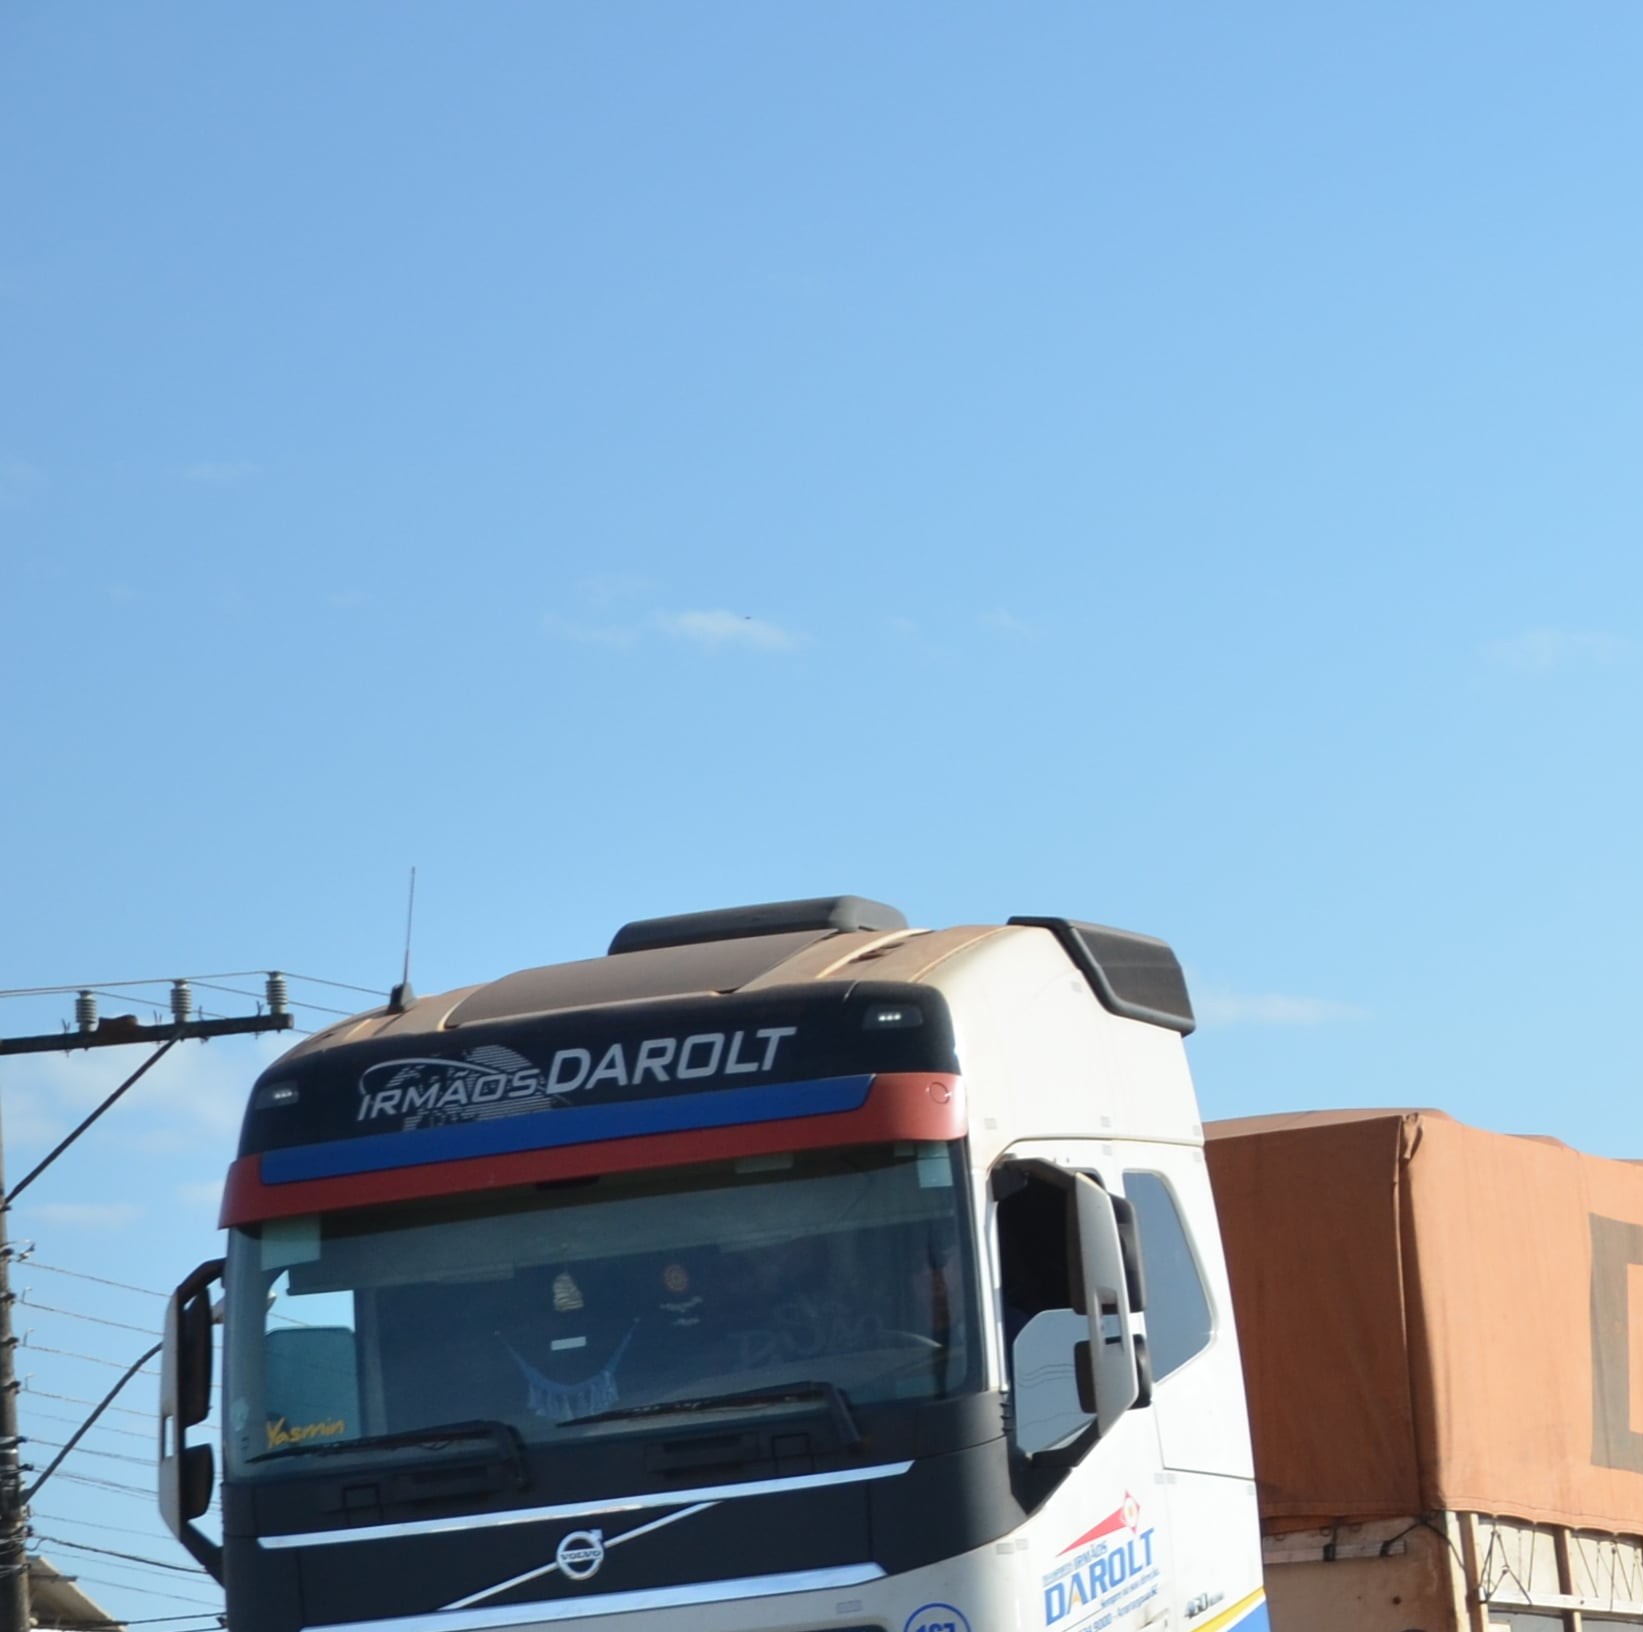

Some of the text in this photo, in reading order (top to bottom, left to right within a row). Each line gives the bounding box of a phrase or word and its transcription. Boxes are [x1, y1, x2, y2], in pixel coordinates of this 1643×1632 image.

[357, 1026, 798, 1121] IRMÃOS DAROLT
[1044, 1527, 1155, 1626] DAROLT
